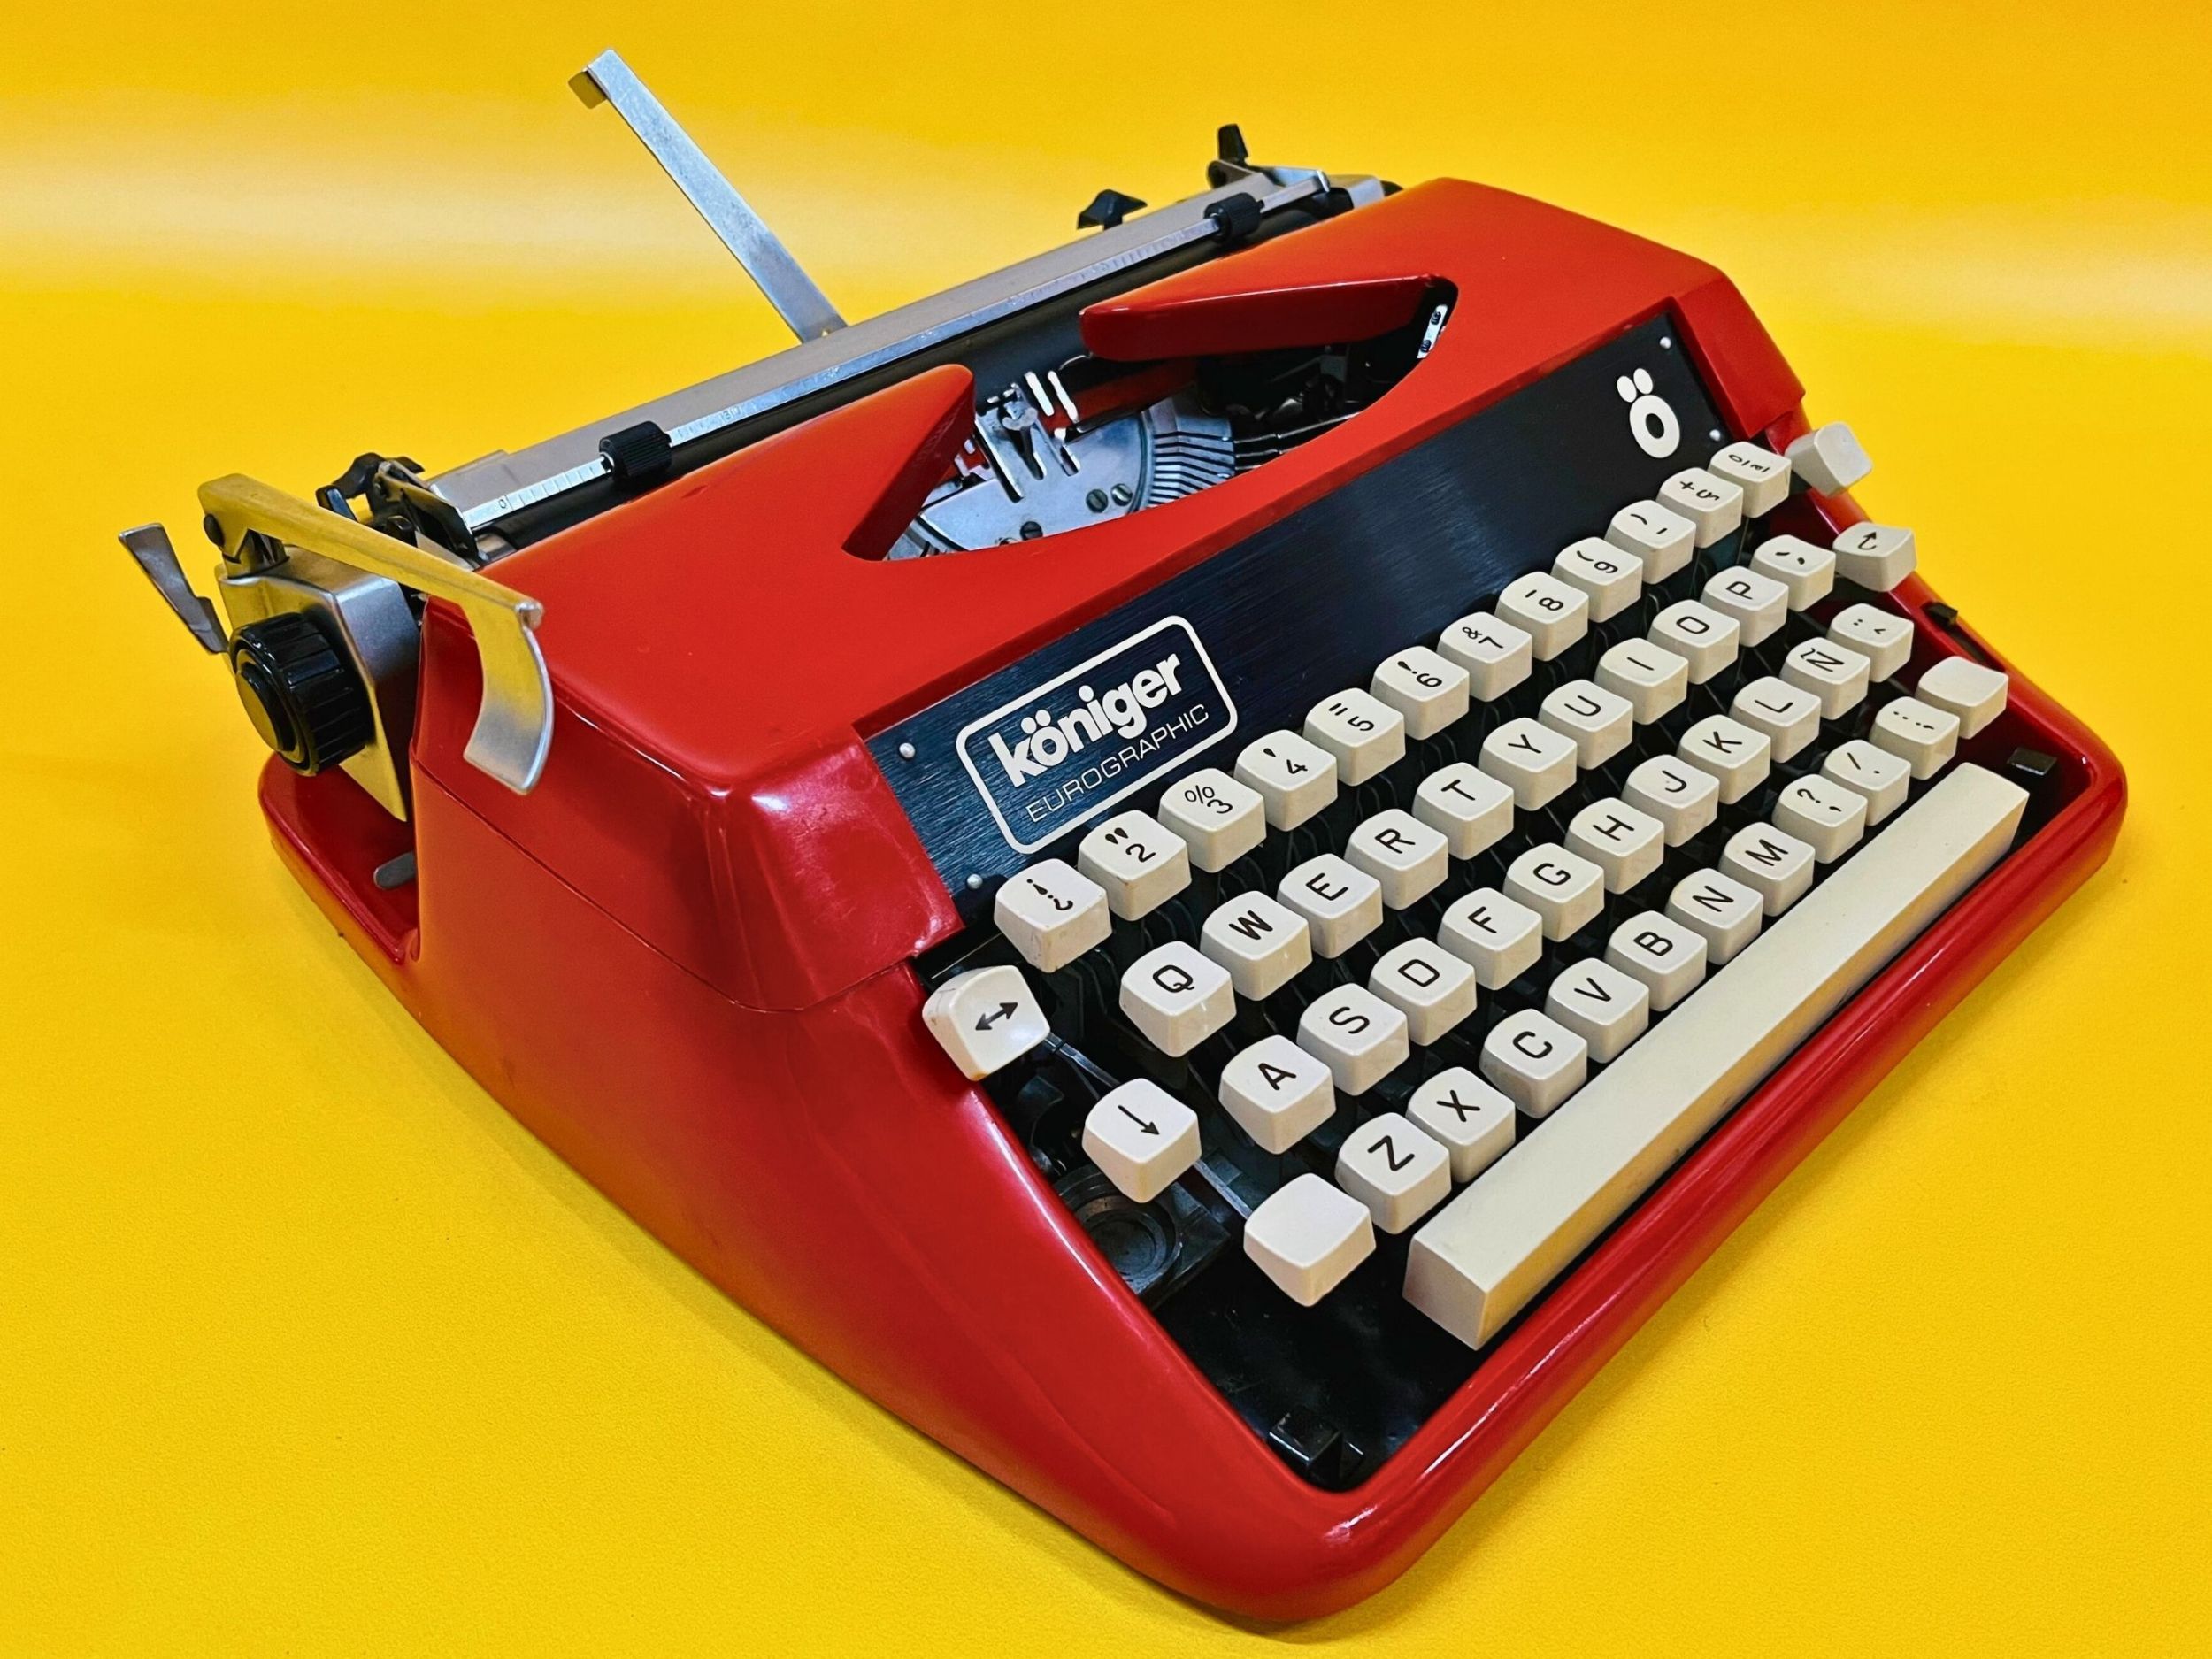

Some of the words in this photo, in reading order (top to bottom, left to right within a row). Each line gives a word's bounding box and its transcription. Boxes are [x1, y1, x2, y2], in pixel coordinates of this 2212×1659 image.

[1680, 481, 1694, 490] +
[1594, 561, 1618, 574] 9
[1725, 580, 1753, 600] P
[1538, 597, 1564, 611] 8
[1462, 626, 1483, 640] &
[1478, 635, 1504, 649] 7
[1397, 660, 1417, 675] !
[1800, 648, 1845, 672] Ñ
[1416, 672, 1443, 687] 6
[1563, 695, 1601, 717] U
[1754, 699, 1793, 714] L
[987, 652, 1182, 787] königer
[1347, 715, 1375, 732] 5
[1507, 733, 1542, 754] Y
[1702, 731, 1743, 754] K
[1025, 703, 1210, 823] EUROGRAPHIC
[1286, 758, 1309, 775] 4
[1440, 779, 1476, 801] T
[1662, 770, 1687, 793] J
[1184, 784, 1216, 804] %
[1796, 788, 1821, 803] ?
[1206, 798, 1233, 815] 3
[1592, 814, 1635, 841] H
[1125, 843, 1156, 863] 2
[1374, 828, 1416, 855] R
[1745, 839, 1789, 867] M
[1532, 863, 1571, 886] G
[1305, 872, 1349, 902] E
[1692, 885, 1734, 913] N
[1228, 910, 1273, 941] W
[1467, 906, 1497, 934] F
[1632, 931, 1674, 957] B
[1152, 964, 1195, 994] Q
[1397, 958, 1440, 988] D
[1573, 977, 1612, 1002] V
[1328, 1006, 1371, 1034] S
[1512, 1031, 1553, 1059] C
[1257, 1063, 1297, 1091] A
[1436, 1089, 1481, 1123] X
[1367, 1134, 1416, 1172] Z
